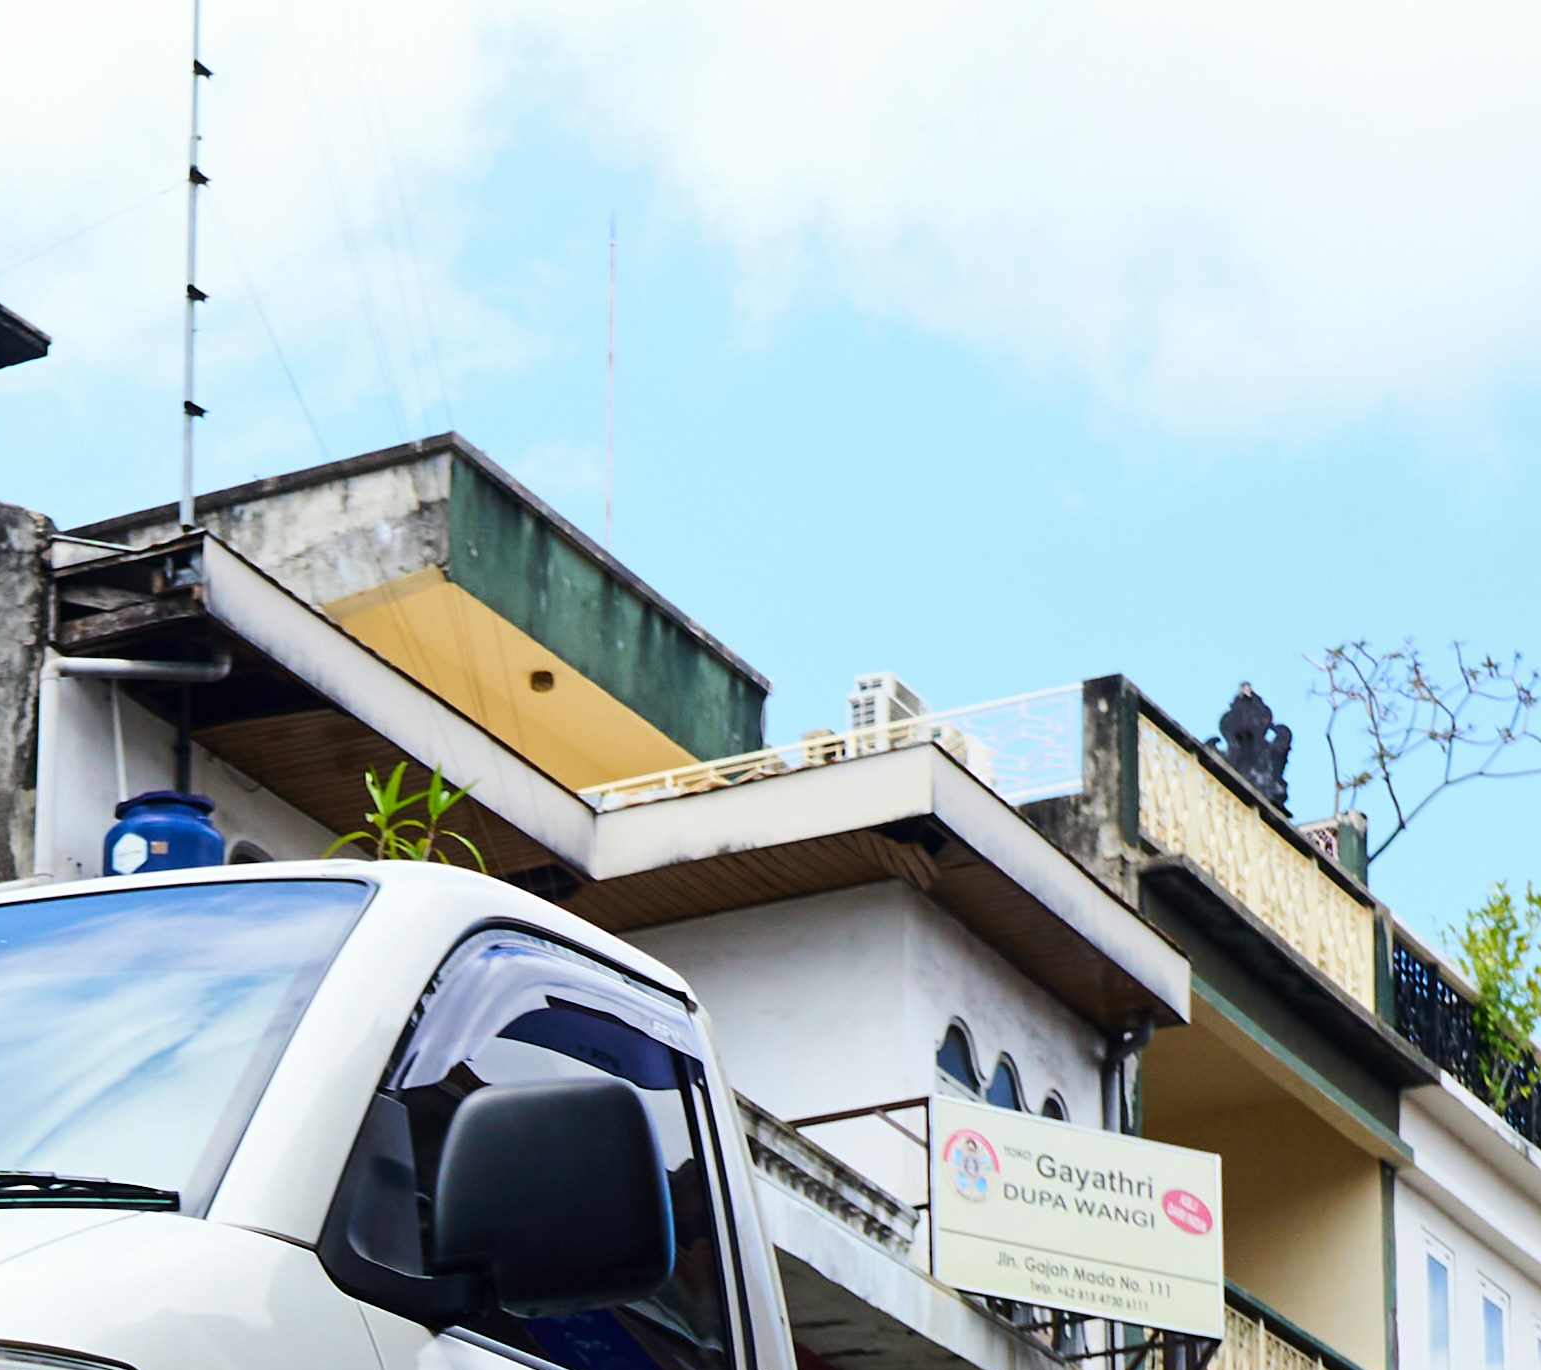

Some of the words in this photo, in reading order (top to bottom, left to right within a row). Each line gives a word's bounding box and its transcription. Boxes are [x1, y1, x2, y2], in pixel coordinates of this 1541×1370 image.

[1035, 1153, 1155, 1201] Gayathri
[1003, 1181, 1068, 1212] DUPA
[1074, 1198, 1156, 1230] WANGI
[1024, 1256, 1069, 1281] Gajah
[1073, 1266, 1116, 1289] Mada
